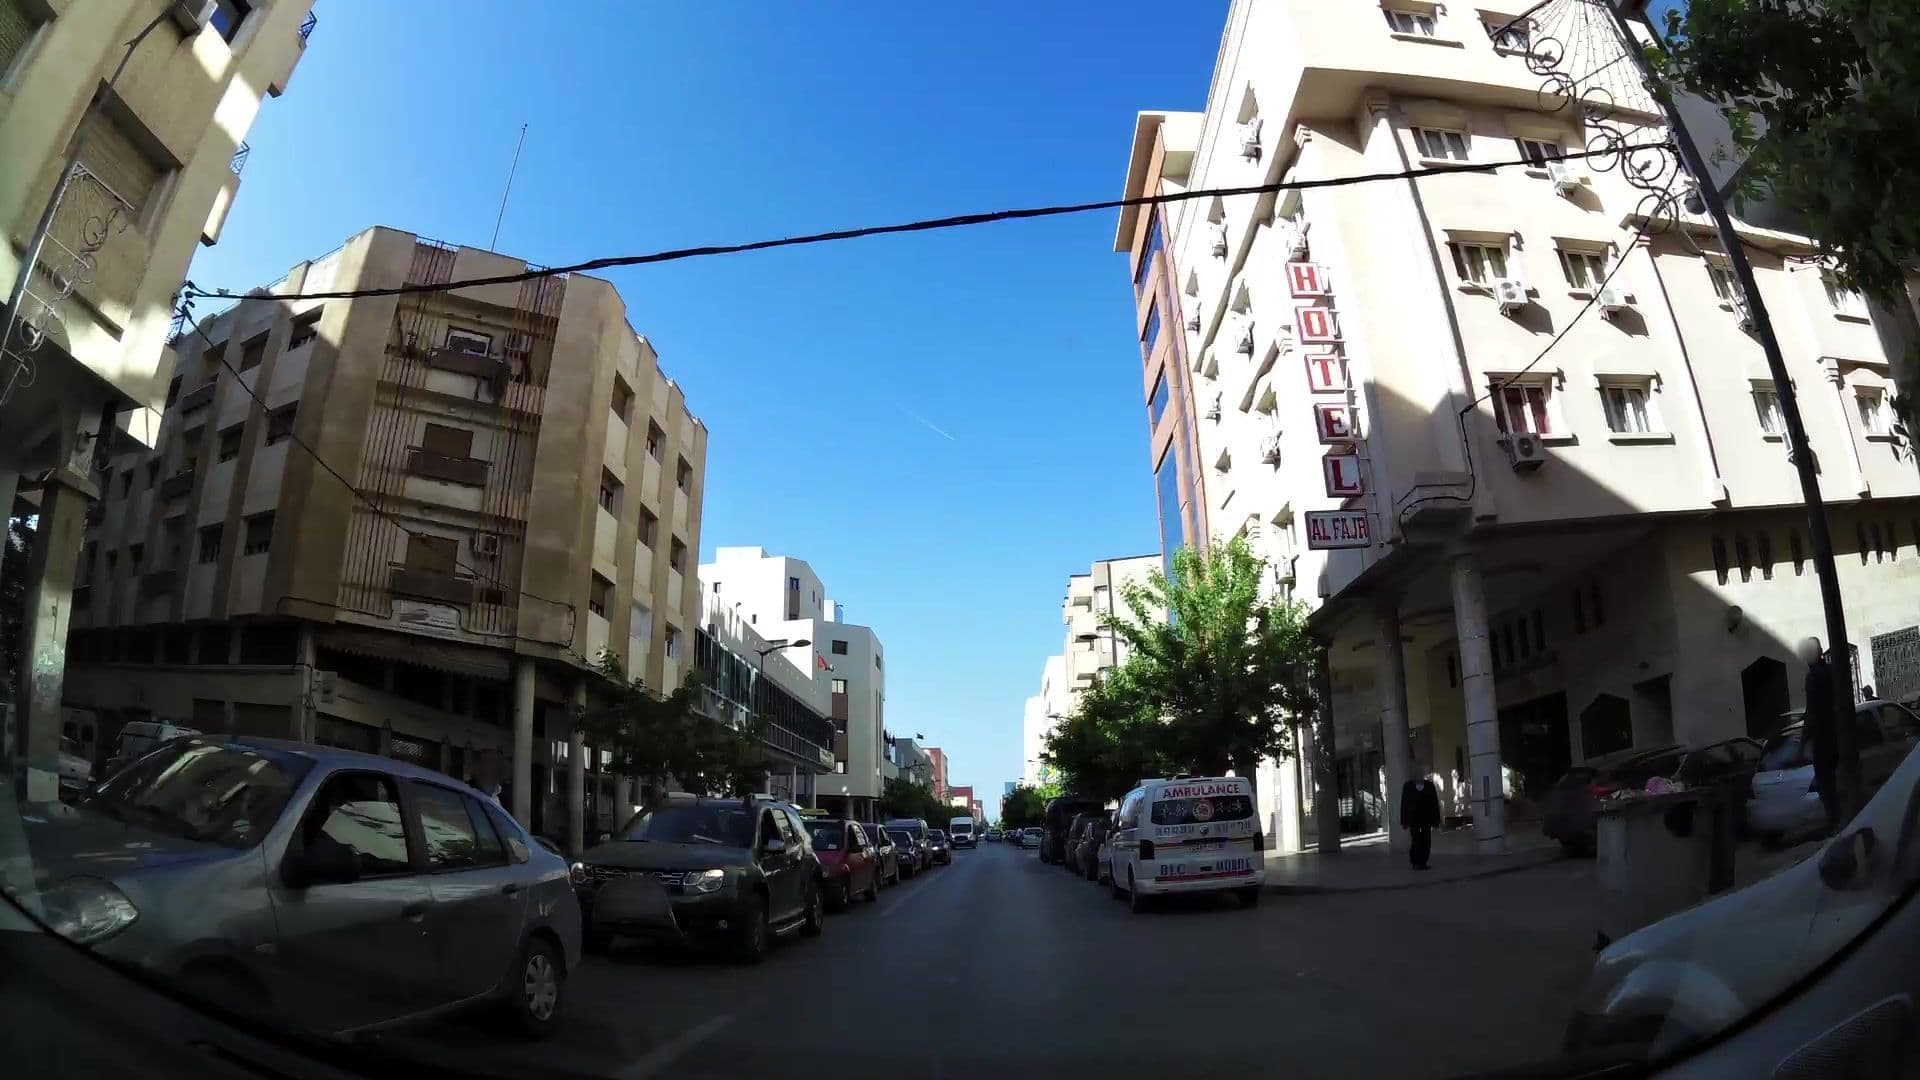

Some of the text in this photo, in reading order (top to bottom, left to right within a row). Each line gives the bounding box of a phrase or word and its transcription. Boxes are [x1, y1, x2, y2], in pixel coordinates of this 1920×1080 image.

[1293, 265, 1359, 491] HOTEL
[1311, 516, 1368, 541] AL FAJR
[1163, 784, 1240, 799] AMBULANCE
